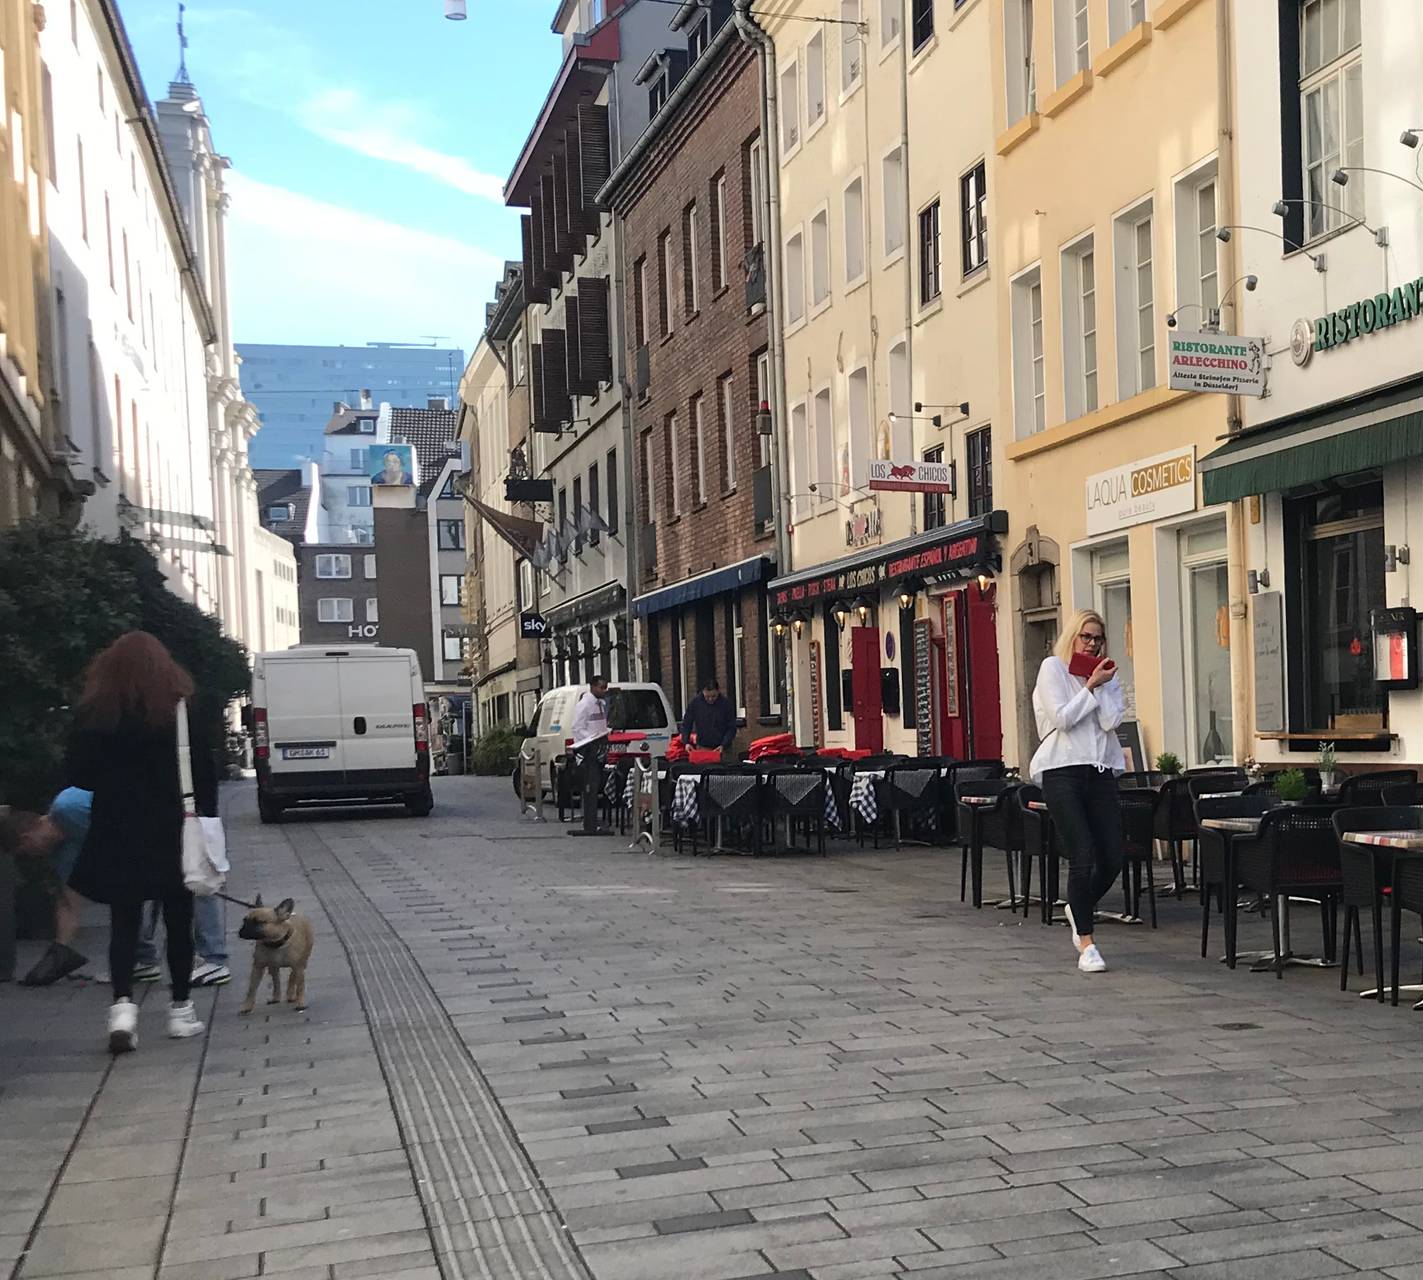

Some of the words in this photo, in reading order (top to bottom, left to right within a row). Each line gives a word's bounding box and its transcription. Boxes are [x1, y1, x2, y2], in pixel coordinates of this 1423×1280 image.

[1172, 341, 1247, 356] RISTORANTE
[1172, 355, 1248, 370] ARLECCHINO
[870, 463, 886, 479] LOS
[918, 466, 948, 482] CHICOS
[1088, 474, 1127, 510] LAQUA
[1131, 457, 1192, 496] COSMETICS
[348, 624, 379, 638] HO
[524, 619, 546, 633] sky
